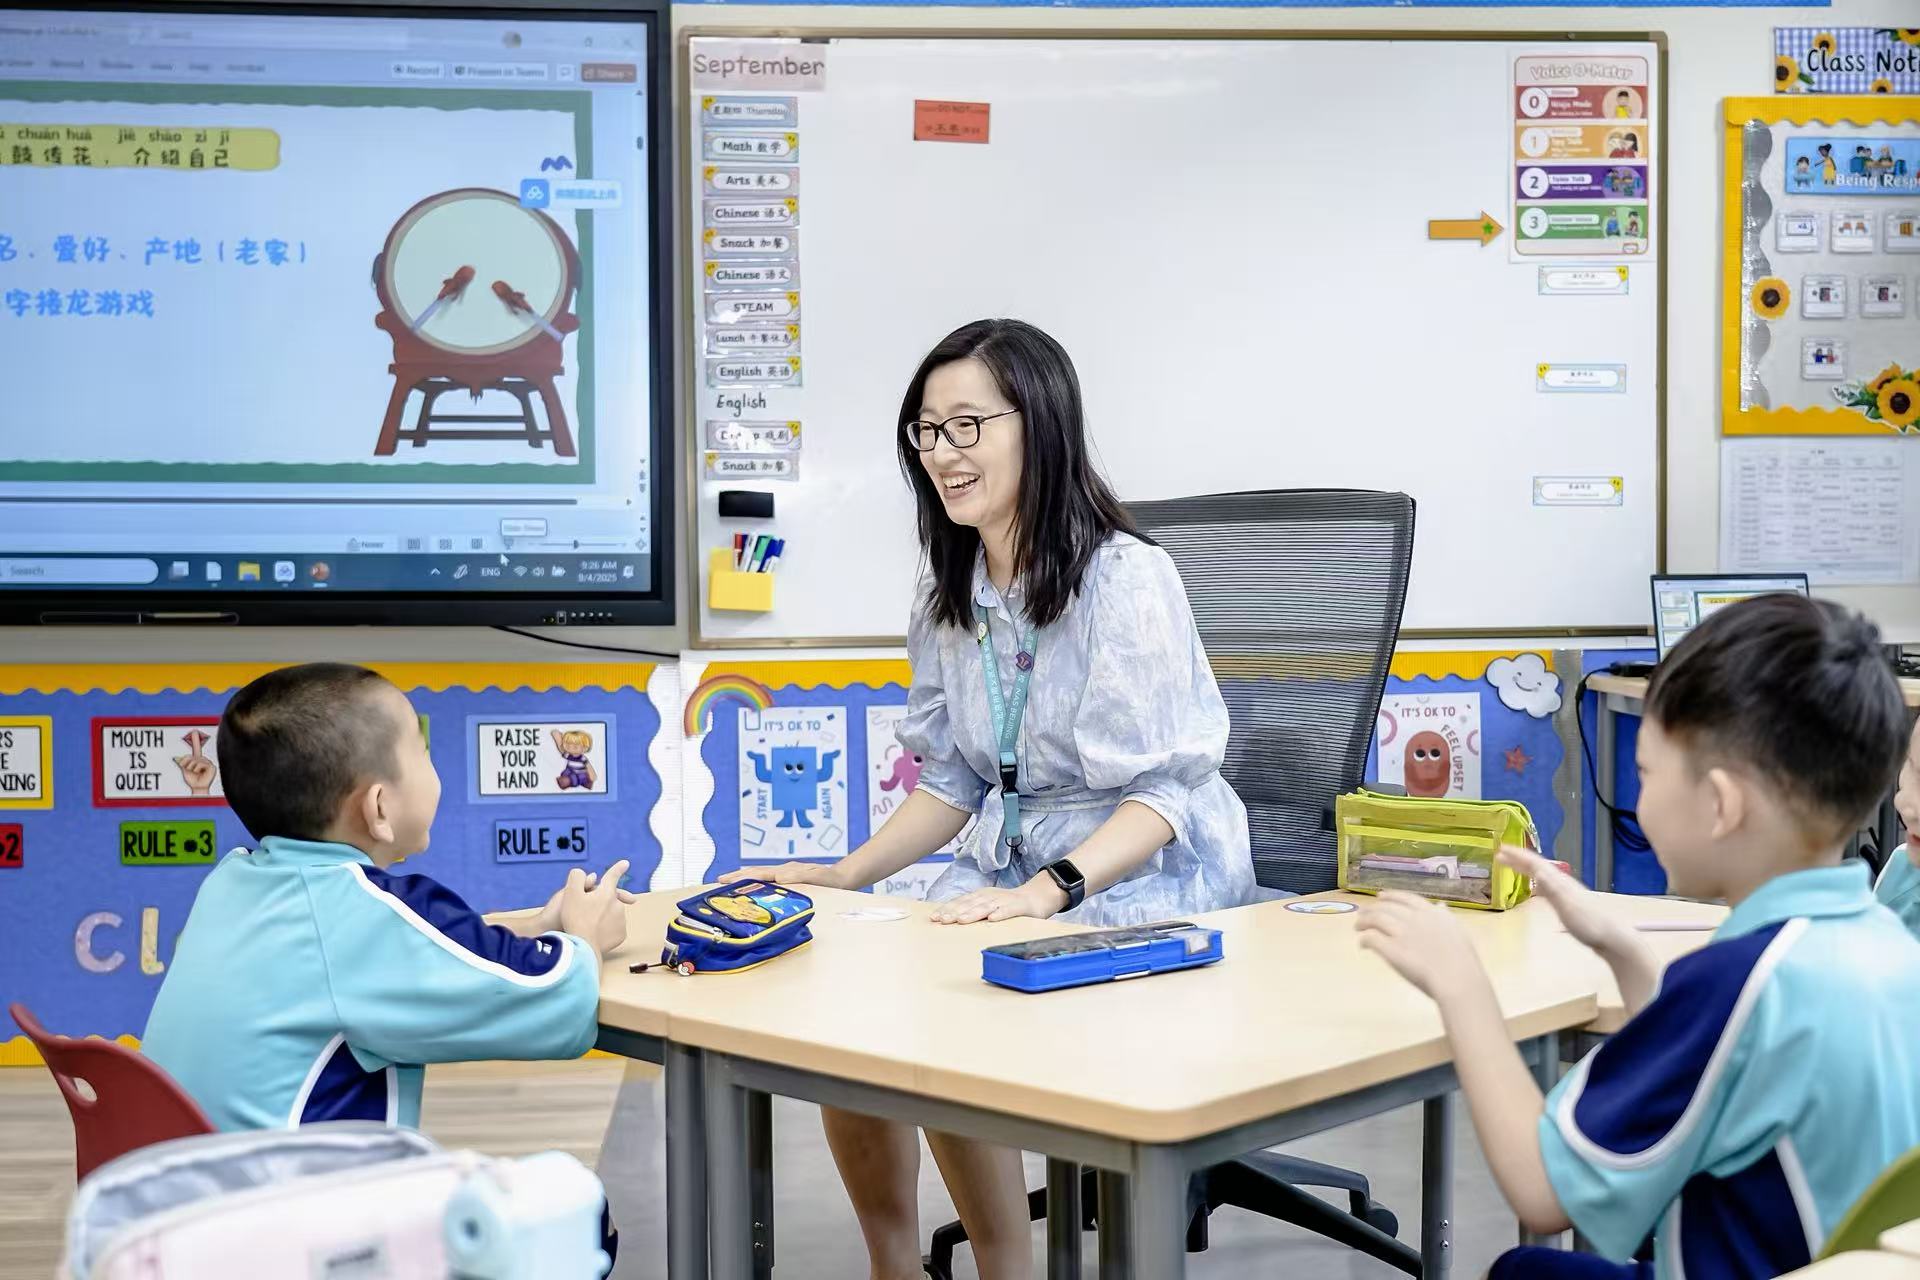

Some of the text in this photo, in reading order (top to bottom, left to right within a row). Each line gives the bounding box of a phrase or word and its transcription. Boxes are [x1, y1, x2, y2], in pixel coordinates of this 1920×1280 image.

[694, 55, 825, 78] September
[1807, 48, 1920, 72] Class Not
[1529, 96, 1540, 108] 0
[722, 142, 752, 153] Math
[726, 175, 751, 186] Arts
[1530, 176, 1539, 189] 2
[1836, 173, 1877, 192] Being
[715, 207, 788, 219] Chinese 语文
[1529, 216, 1539, 229] 3
[720, 238, 755, 248] Snack
[716, 269, 789, 280] Chinese 语文
[734, 302, 774, 312] STEAM
[716, 334, 744, 344] Lunch
[720, 366, 790, 380] English 英语
[716, 391, 767, 417] English
[722, 461, 756, 471] Snack
[481, 567, 500, 577] ENG
[602, 562, 617, 570] AM
[1401, 706, 1456, 718] IT'S OK TO
[764, 720, 821, 731] IT'S OK TO
[1003, 706, 1017, 740] BEIJING
[112, 730, 164, 748] MOUTH
[495, 728, 541, 746] RAISE
[1440, 724, 1461, 753] FEEL
[129, 752, 147, 769] IS
[500, 750, 536, 767] YOUR
[115, 773, 161, 791] QUIET
[498, 771, 539, 789] HAND
[1453, 755, 1464, 792] UPSET
[757, 788, 768, 820] START
[822, 788, 832, 819] AGAIN
[123, 830, 177, 857] RULE
[498, 828, 551, 855] RULE
[886, 880, 927, 893] DON'T
[75, 907, 168, 975] Cl
